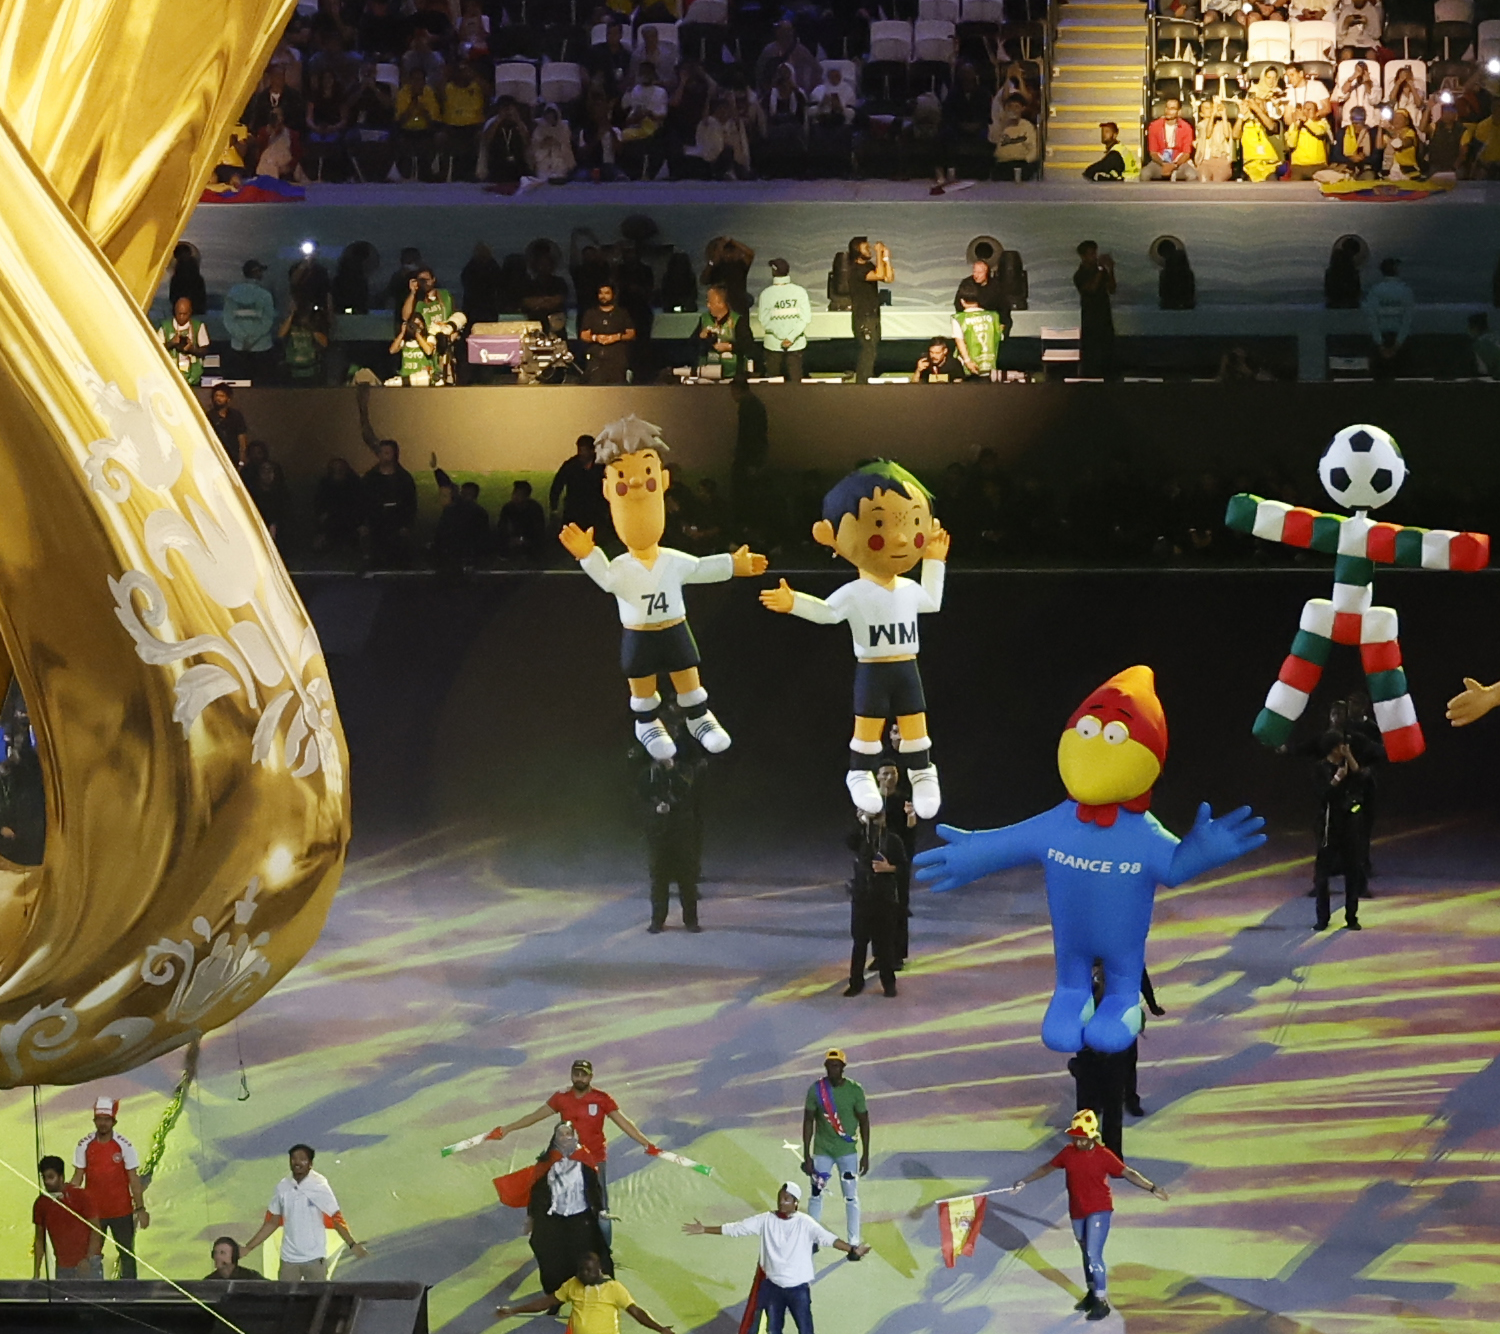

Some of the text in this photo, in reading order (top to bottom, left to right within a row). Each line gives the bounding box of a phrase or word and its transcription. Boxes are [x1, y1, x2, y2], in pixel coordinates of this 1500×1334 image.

[774, 299, 797, 309] 4057
[641, 591, 670, 616] 74
[869, 621, 916, 647] WM
[1047, 846, 1142, 874] FRANCE 98
